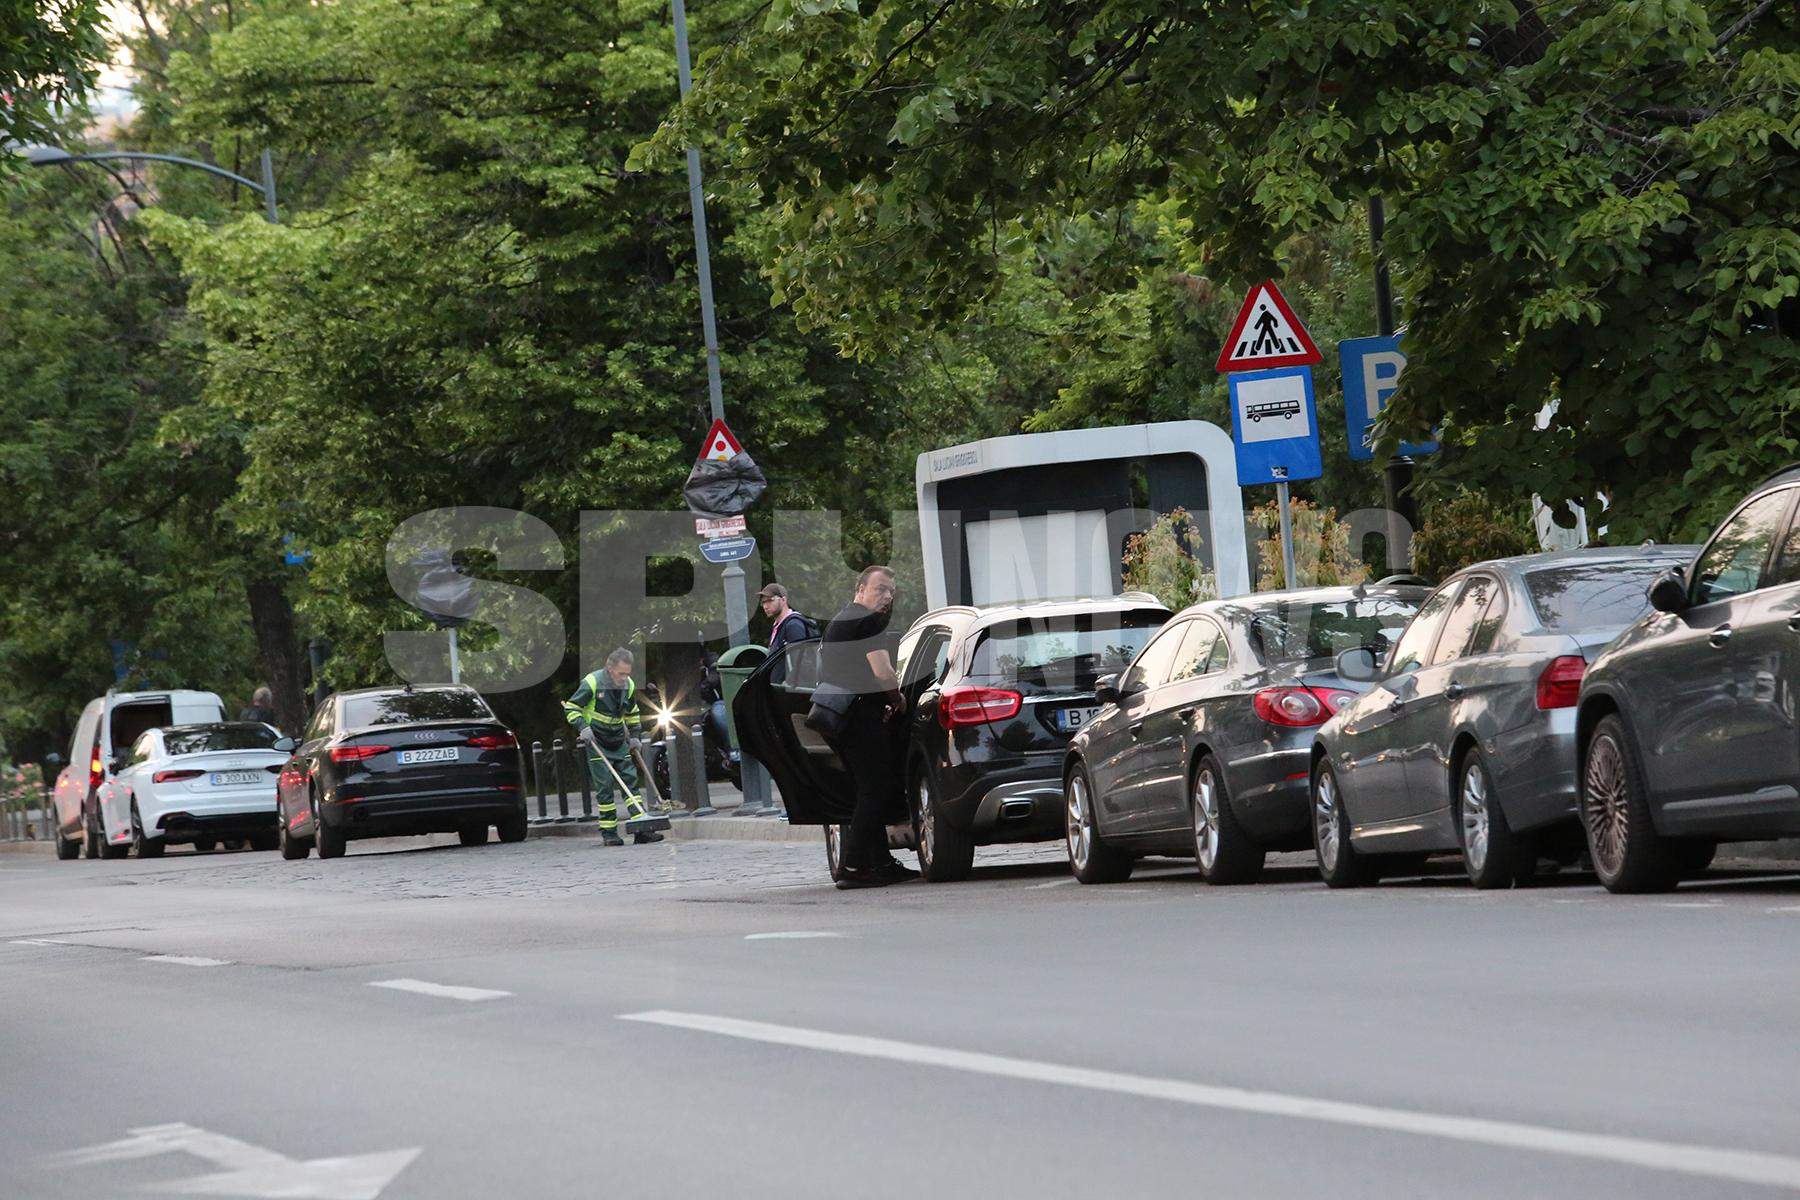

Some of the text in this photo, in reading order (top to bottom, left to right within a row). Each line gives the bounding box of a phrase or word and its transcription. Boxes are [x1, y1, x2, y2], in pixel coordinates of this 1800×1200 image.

[1362, 351, 1407, 419] P
[1070, 710, 1082, 726] B
[404, 752, 412, 762] B
